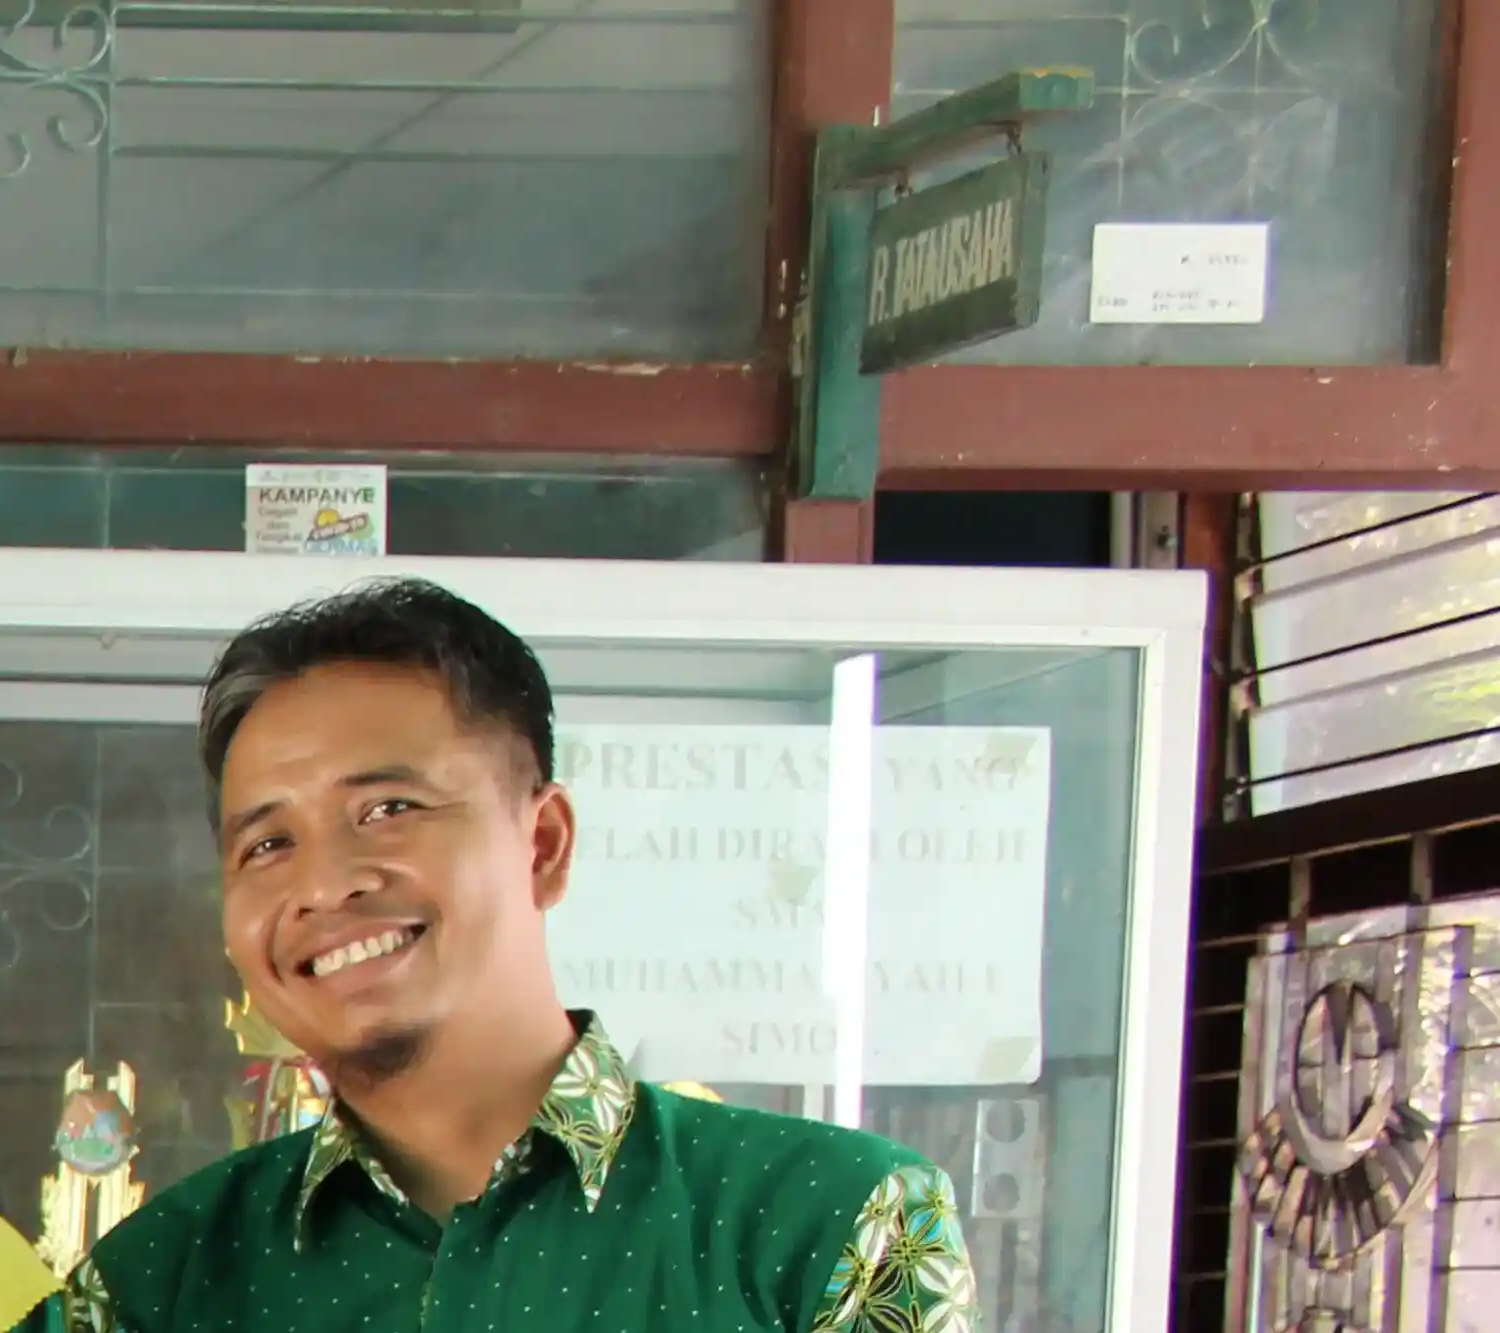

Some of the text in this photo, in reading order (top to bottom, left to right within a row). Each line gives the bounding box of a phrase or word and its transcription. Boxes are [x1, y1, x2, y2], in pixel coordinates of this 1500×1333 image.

[259, 486, 376, 505] KAMPANYE
[575, 825, 699, 863] ELAH
[896, 827, 1027, 864] OLEH
[723, 1020, 838, 1056] SIMO
